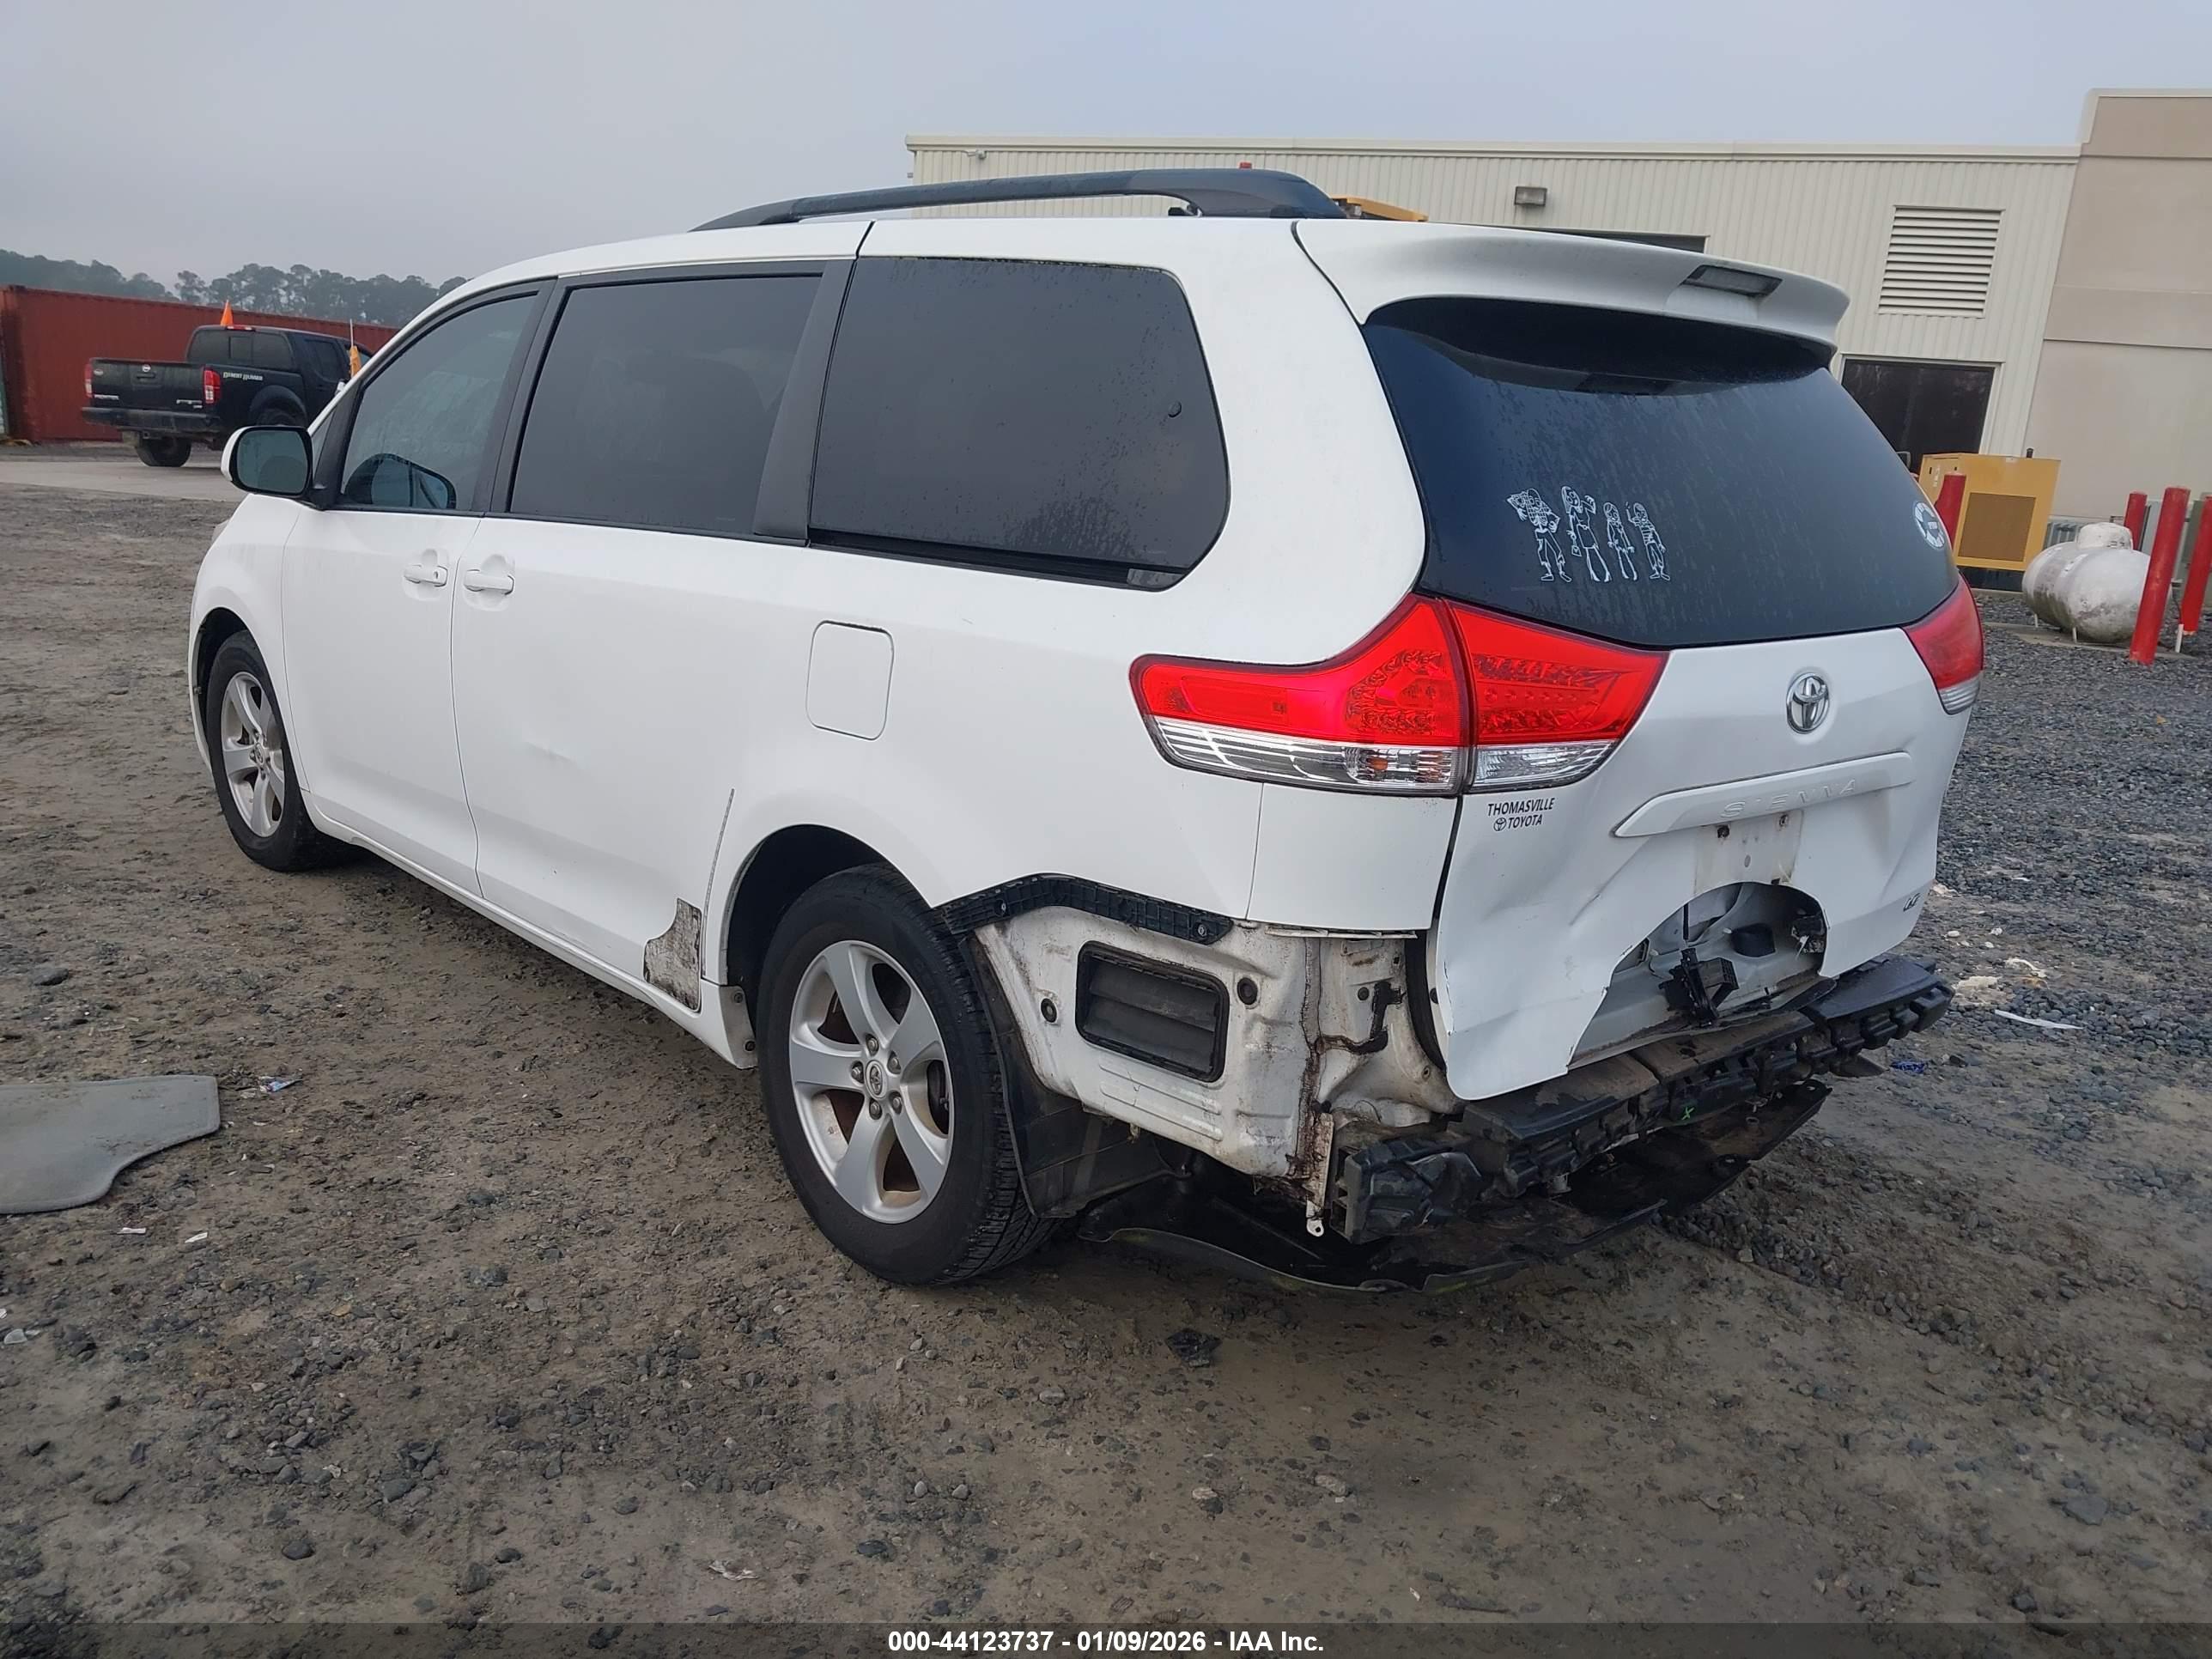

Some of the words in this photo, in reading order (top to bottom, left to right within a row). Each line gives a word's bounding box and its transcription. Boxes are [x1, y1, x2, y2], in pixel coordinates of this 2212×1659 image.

[1487, 798, 1555, 817] THOMASVILLE
[1719, 779, 1856, 817] SEA
[1508, 814, 1543, 829] TOYOTA
